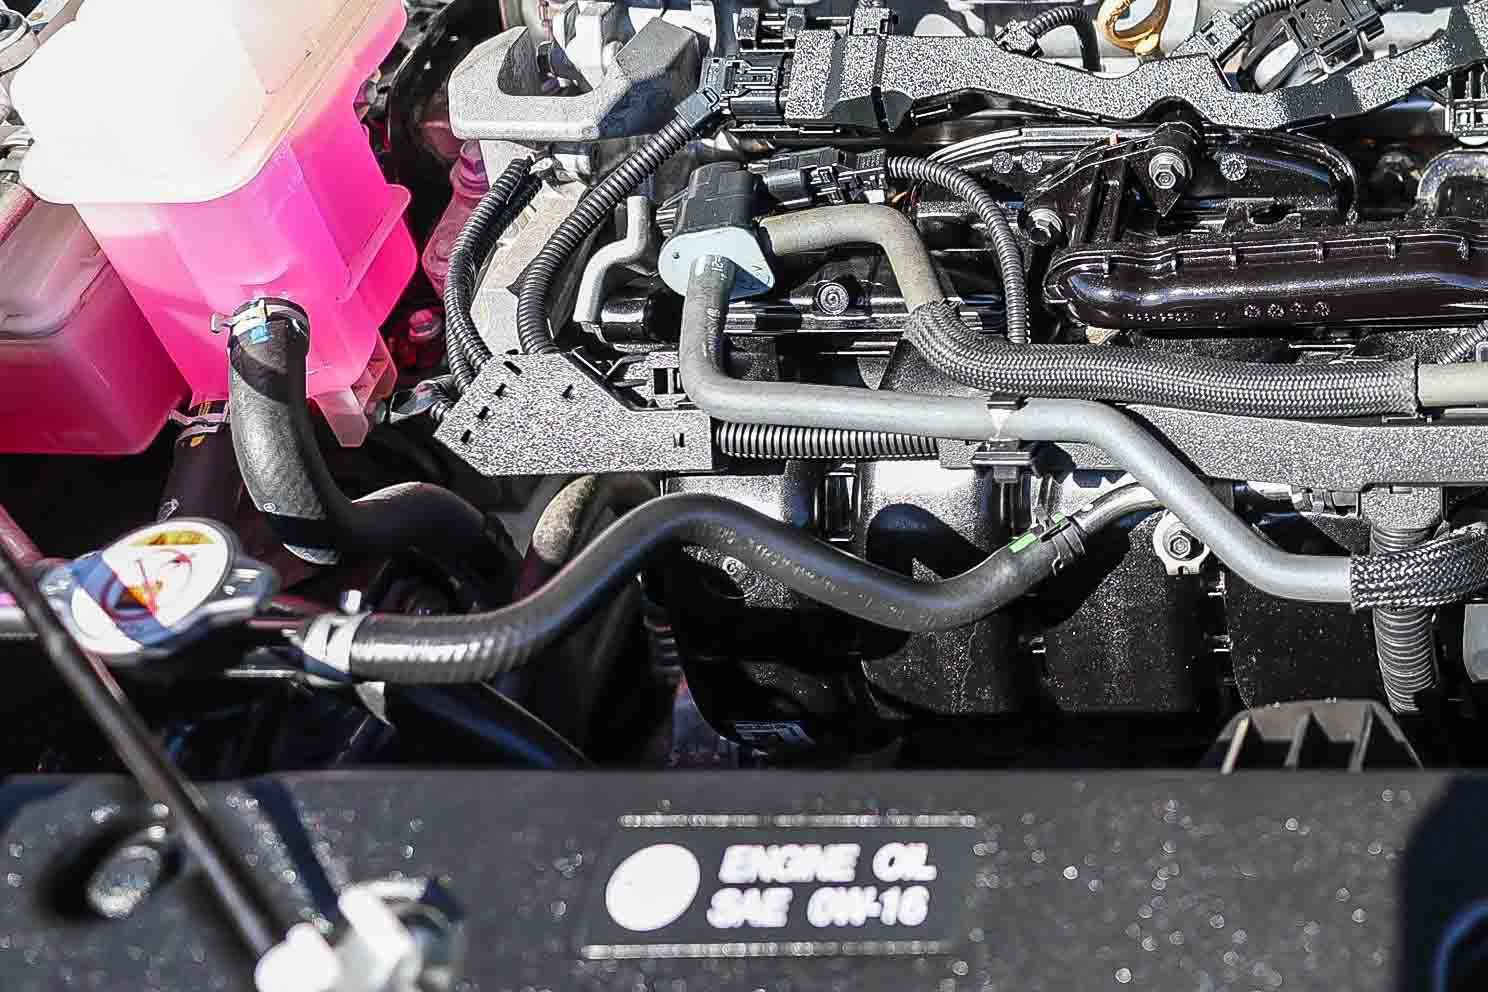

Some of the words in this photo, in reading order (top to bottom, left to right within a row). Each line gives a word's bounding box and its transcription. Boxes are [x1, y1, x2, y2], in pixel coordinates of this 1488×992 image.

[718, 843, 861, 883] ENGINE
[872, 842, 937, 882] OIL
[706, 886, 793, 928] SAE
